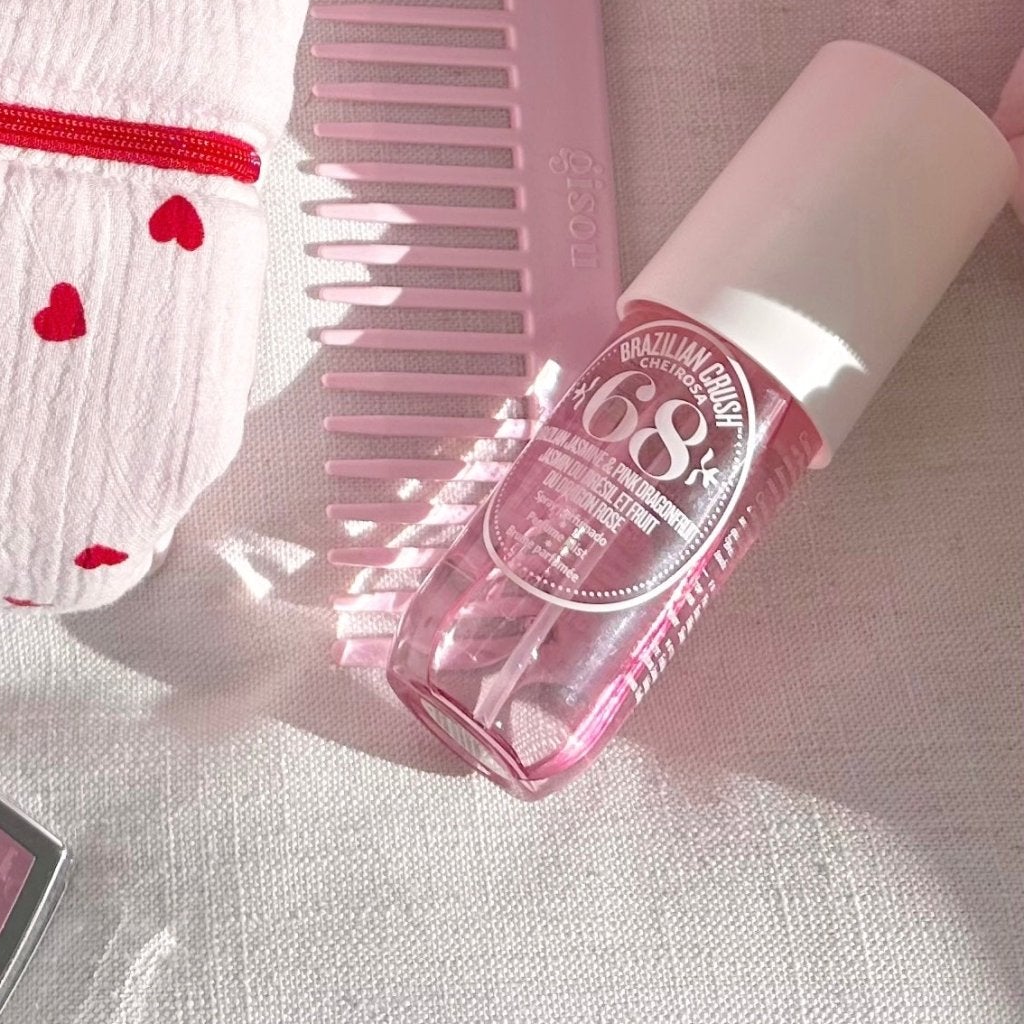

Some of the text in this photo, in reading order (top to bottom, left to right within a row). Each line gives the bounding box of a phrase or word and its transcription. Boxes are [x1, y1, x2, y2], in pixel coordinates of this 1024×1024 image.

[548, 147, 605, 269] gisou
[582, 370, 709, 481] 68
[619, 331, 744, 427] BRAZILIAN CRUSH
[639, 356, 708, 407] CHEIROSA
[537, 447, 576, 474] JASMIN
[567, 460, 589, 481] DU
[613, 491, 635, 513] ET
[625, 501, 661, 536] FRUIT
[542, 470, 563, 489] DU
[592, 500, 627, 535] ROSE
[563, 434, 609, 467] JASMINE
[601, 457, 617, 475] &
[611, 462, 644, 493] PINK
[635, 479, 702, 544] DRAGONFRUIT
